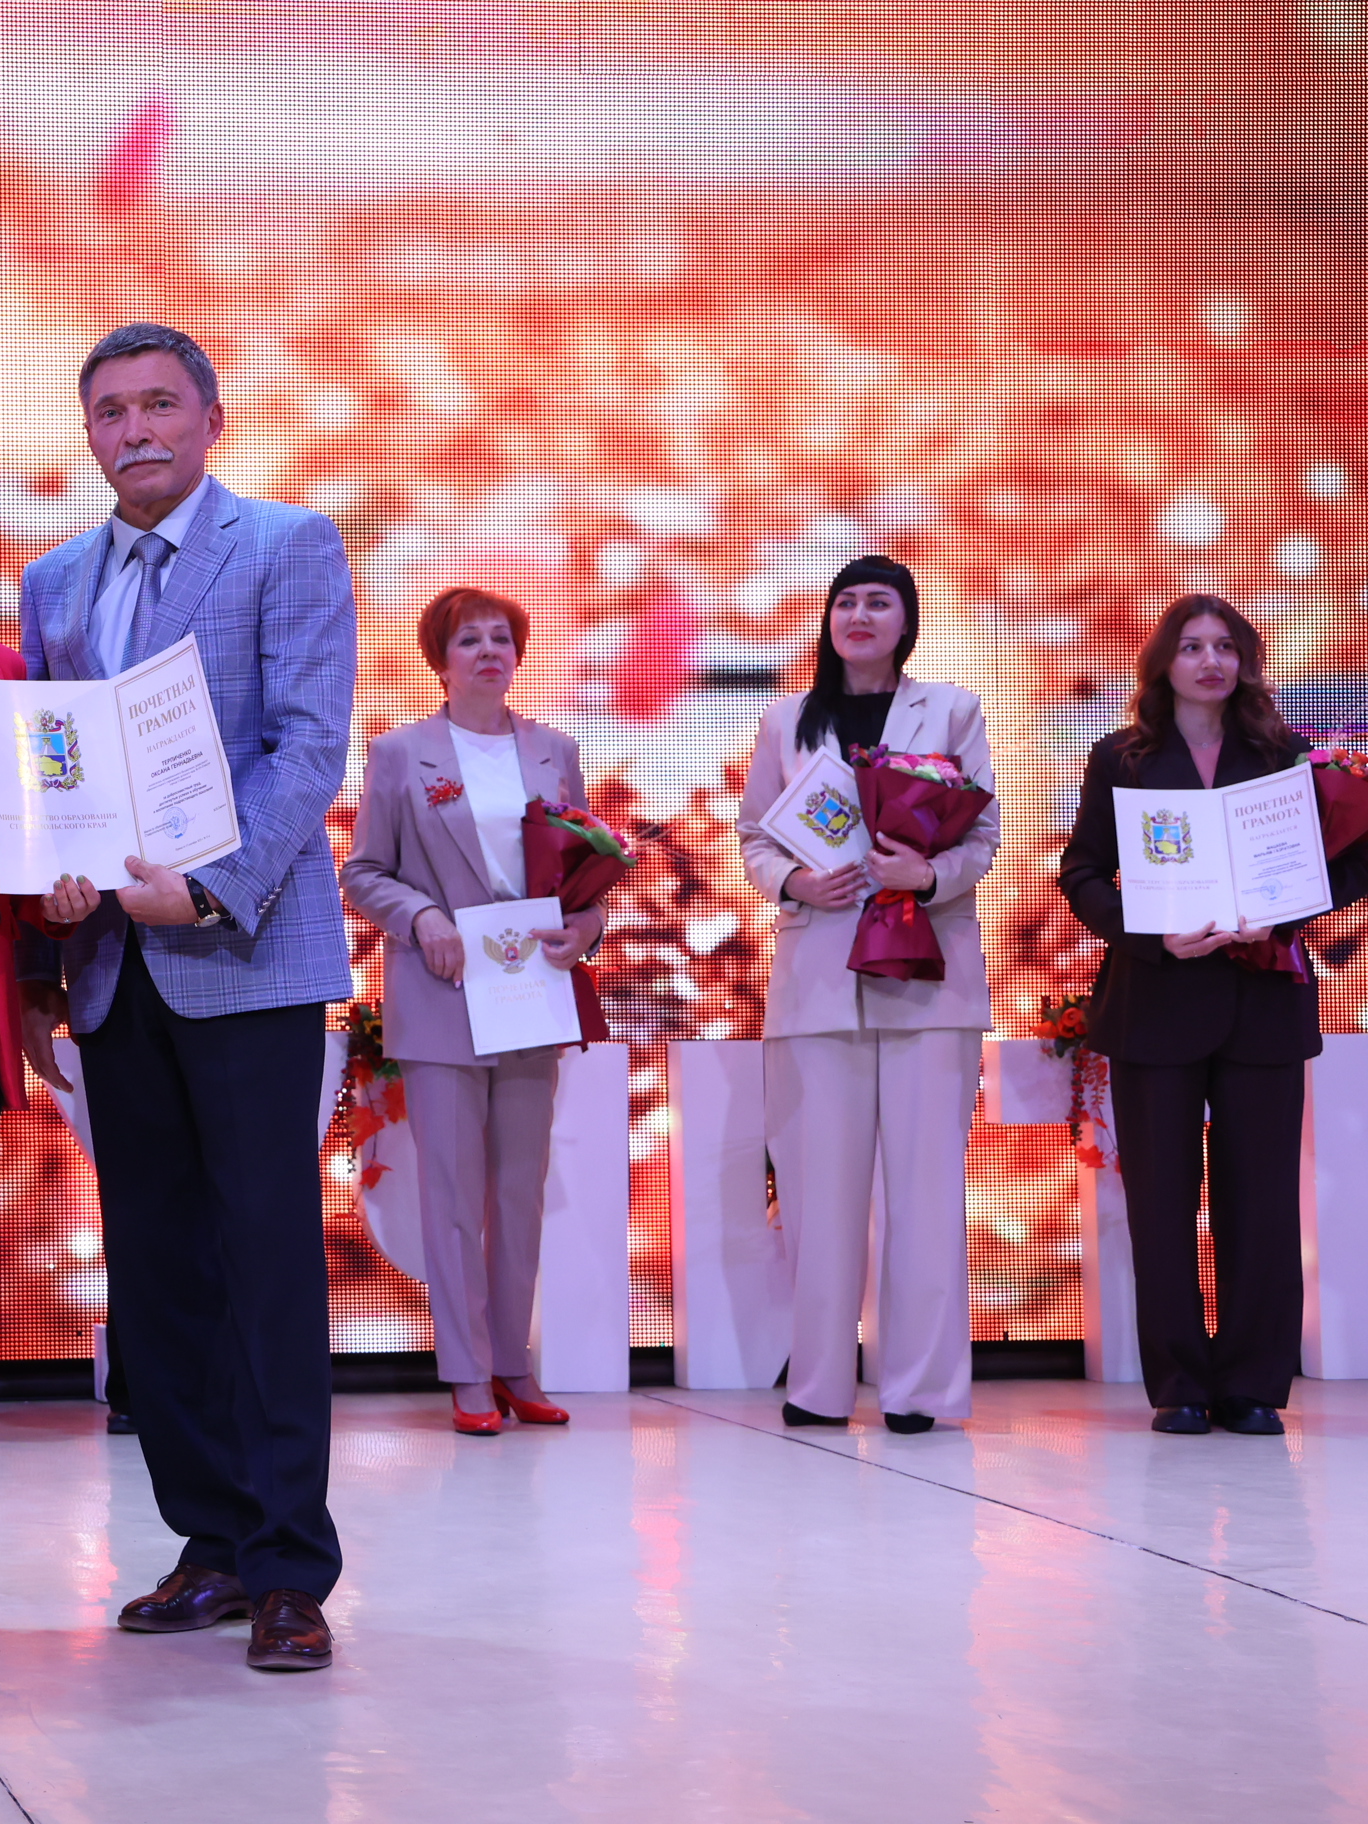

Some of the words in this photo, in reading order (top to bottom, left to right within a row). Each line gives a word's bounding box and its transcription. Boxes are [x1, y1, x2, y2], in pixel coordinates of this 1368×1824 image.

[128, 674, 195, 720] ПОЧЕТНАЯ
[137, 699, 196, 737] ГРАМОТА
[146, 725, 197, 753] НАГРАЖДАЕТСЯ
[150, 766, 171, 779] ОКСАНА
[170, 751, 204, 770] ГЕННАДЬЕВНА
[61, 812, 118, 821] ОБРАЗОВАНИЯ
[1234, 790, 1303, 818] ПОЧЕТНАЯ
[9, 822, 86, 830] СТОЛЬСКОГО
[87, 821, 108, 829] КРАЯ
[1242, 807, 1301, 830] ГРАМОТА
